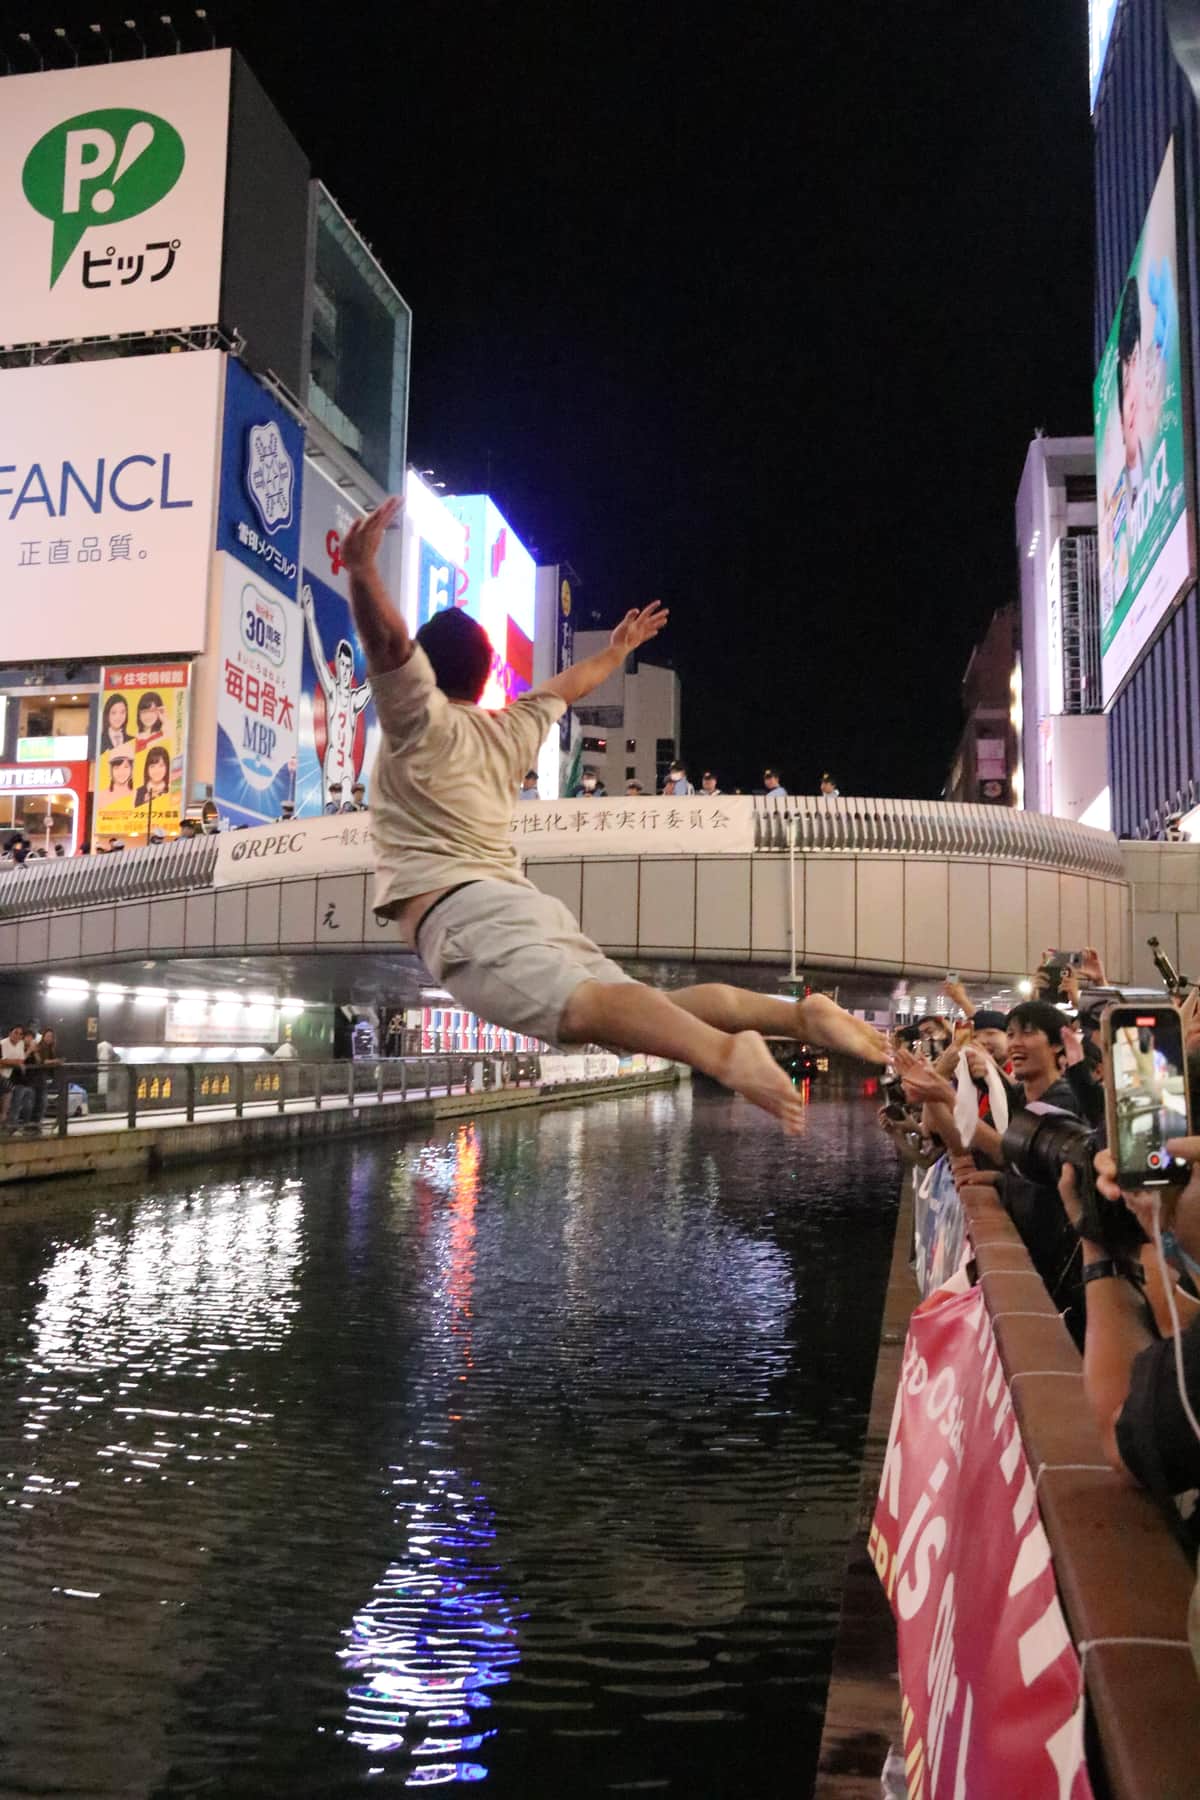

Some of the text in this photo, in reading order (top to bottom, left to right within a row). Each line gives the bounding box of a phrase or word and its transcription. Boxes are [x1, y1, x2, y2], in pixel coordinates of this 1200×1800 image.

[81, 238, 182, 290] ピップ
[224, 657, 294, 733] 毎日骨太
[242, 714, 278, 760] MBP
